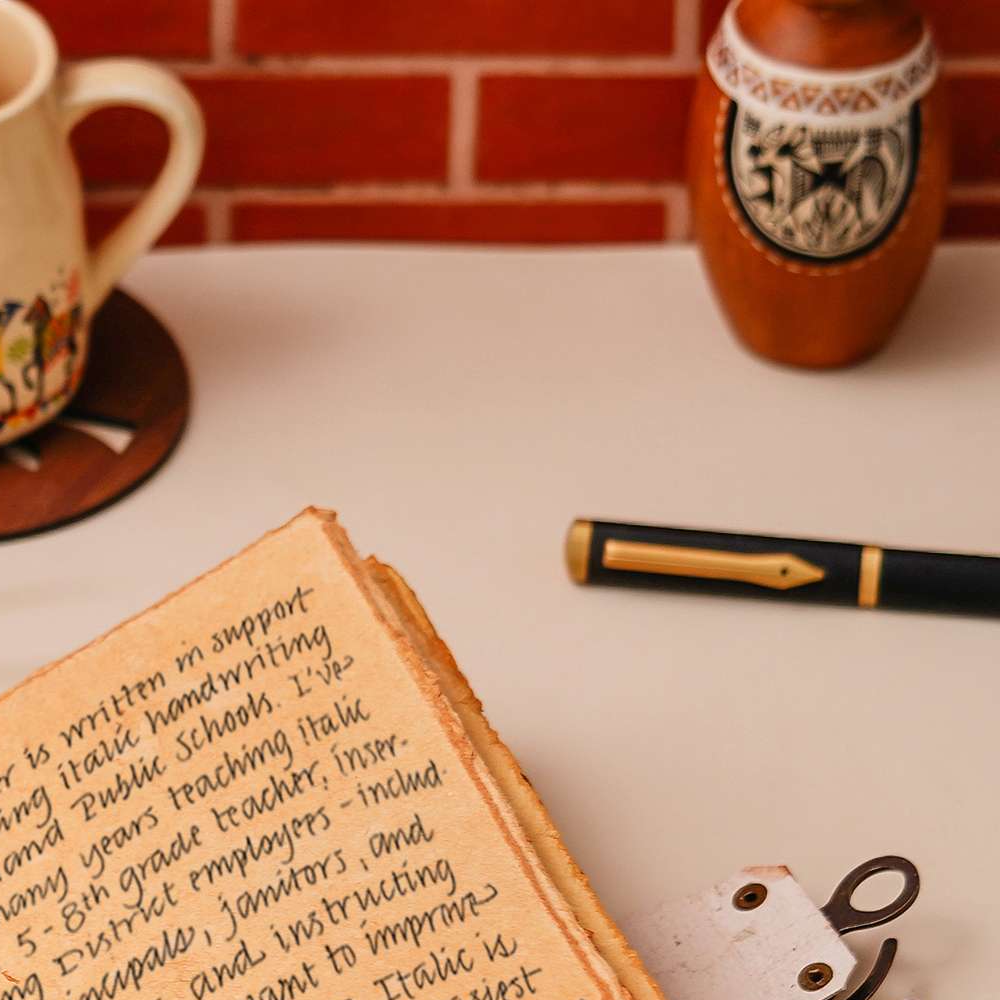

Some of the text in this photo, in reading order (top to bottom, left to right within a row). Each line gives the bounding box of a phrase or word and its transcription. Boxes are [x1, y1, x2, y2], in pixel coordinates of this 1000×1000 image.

[24, 744, 51, 768] is
[60, 671, 166, 749] written
[175, 640, 205, 673] in
[212, 586, 314, 654] support
[58, 723, 140, 790] italic
[144, 624, 332, 735] handwriting
[70, 754, 166, 822] Public
[288, 656, 354, 698] I've
[79, 807, 159, 879] years
[167, 729, 293, 810] teaching
[297, 695, 370, 746] italic
[369, 813, 434, 858] and
[52, 881, 179, 977] District
[190, 806, 331, 892] employees
[119, 823, 201, 909] grade
[190, 941, 266, 1000] and
[274, 858, 456, 954] instructing
[327, 943, 357, 976] to
[364, 883, 499, 957] improve
[476, 933, 518, 960] is
